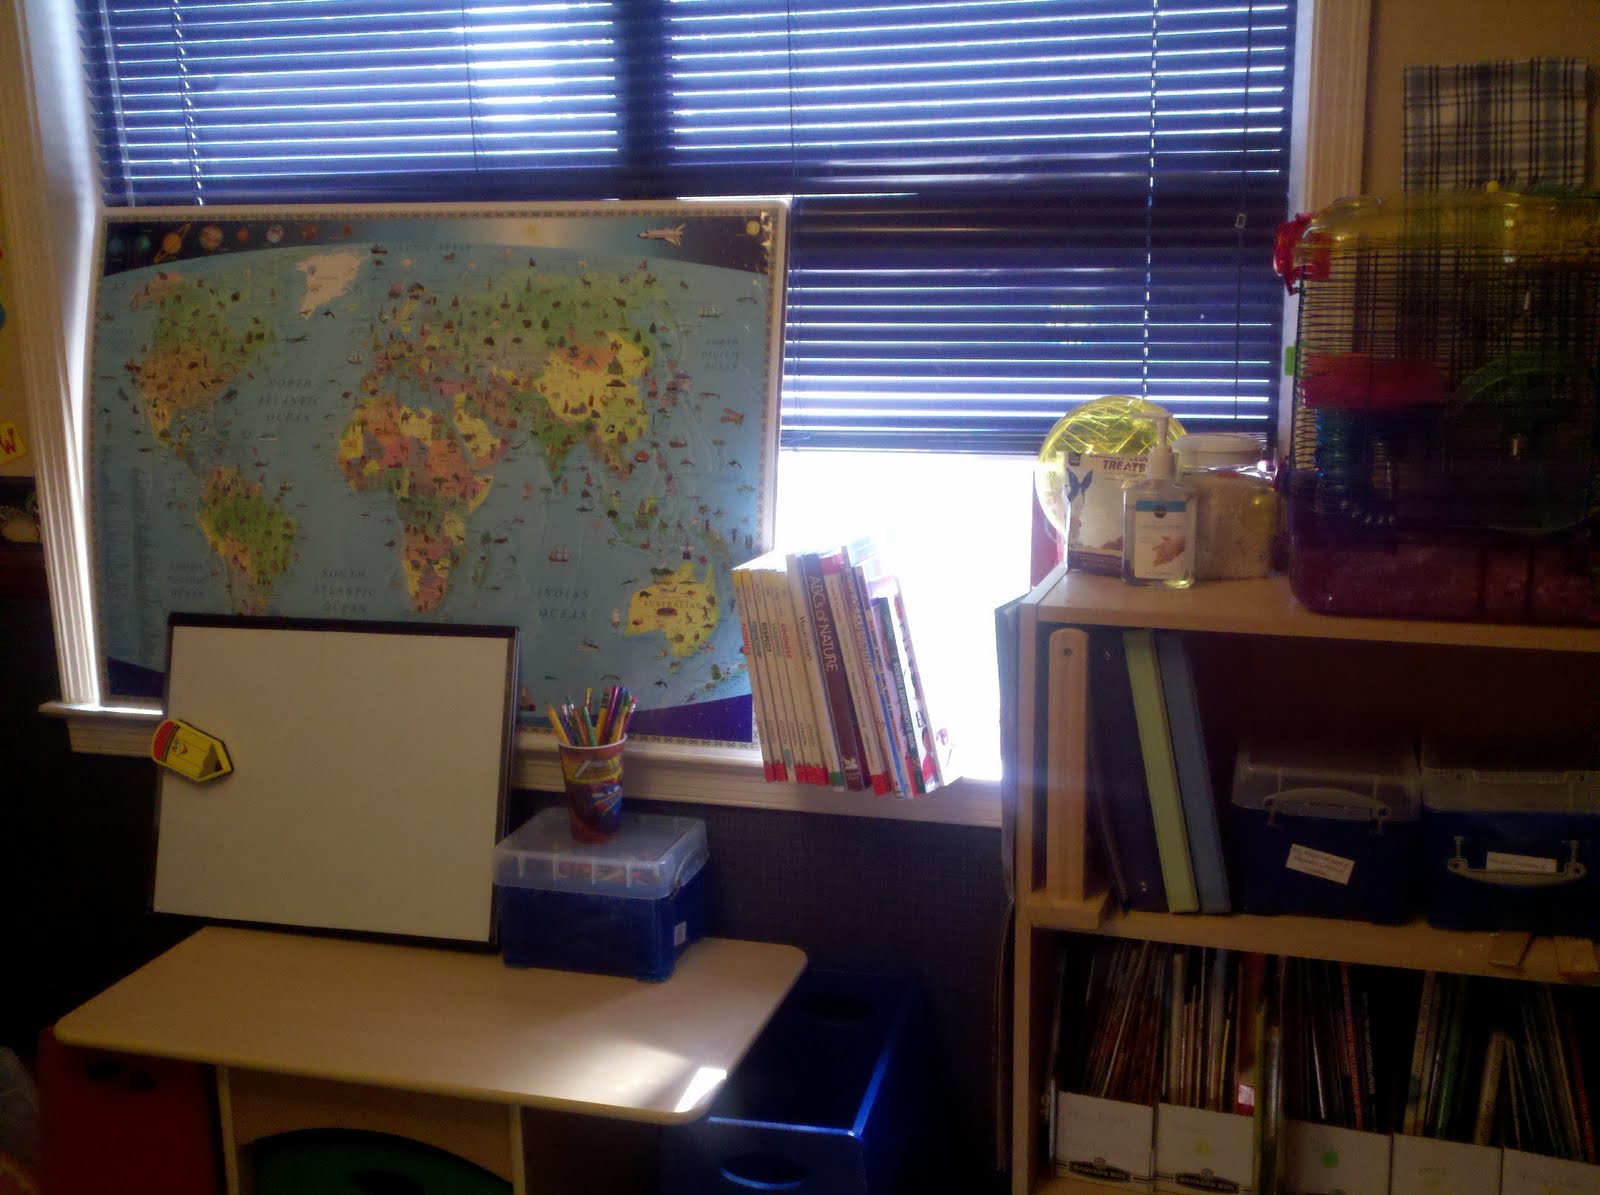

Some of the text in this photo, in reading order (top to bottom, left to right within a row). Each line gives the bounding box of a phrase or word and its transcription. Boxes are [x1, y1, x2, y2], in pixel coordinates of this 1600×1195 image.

[1102, 460, 1147, 473] TREATS
[814, 609, 829, 624] of
[761, 622, 772, 653] RESPECT
[780, 623, 792, 658] KINDNESS
[817, 623, 838, 672] NATURE
[893, 662, 916, 749] SCIENCE EXPERIMENTS BOOK
